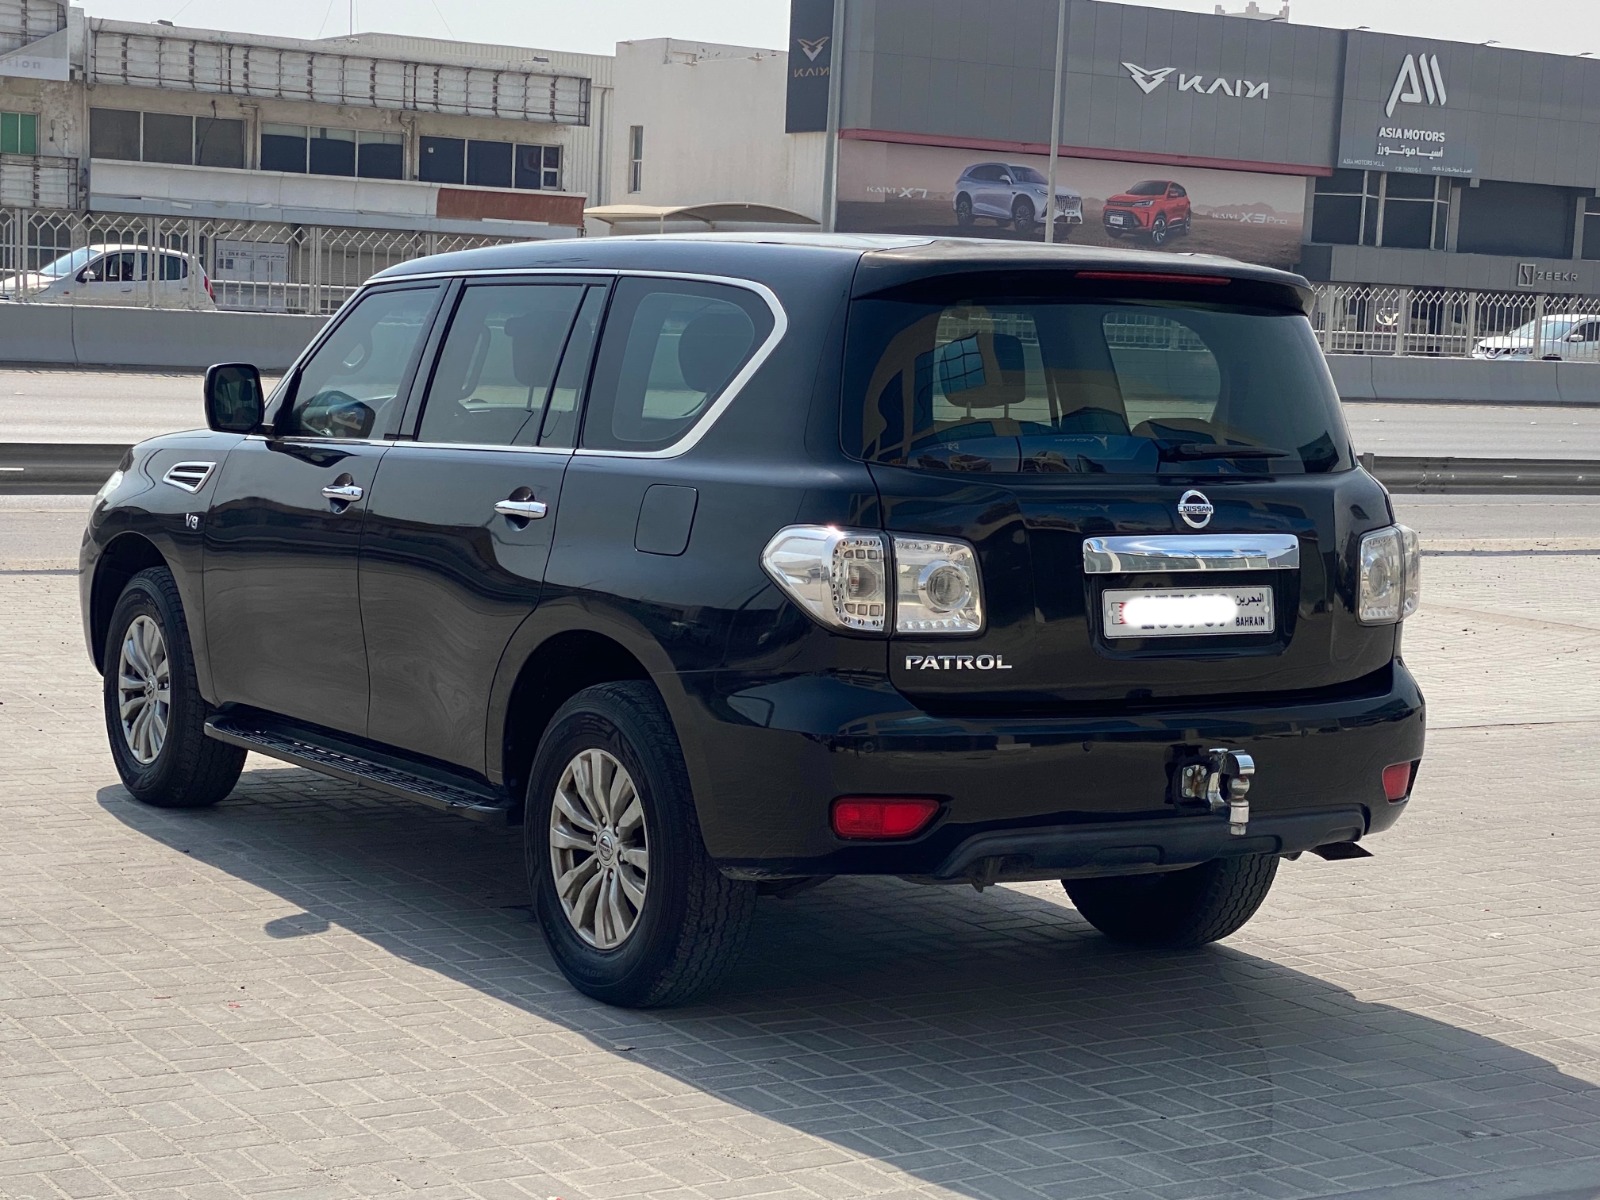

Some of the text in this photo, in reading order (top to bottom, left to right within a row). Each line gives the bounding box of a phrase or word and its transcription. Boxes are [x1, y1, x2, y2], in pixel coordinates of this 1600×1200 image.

[1379, 127, 1445, 142] ASIA MOTORS
[898, 187, 928, 199] X7
[1240, 212, 1267, 224] X3
[1537, 271, 1578, 281] ZEEKR
[185, 512, 199, 530] V8
[1235, 593, 1264, 606] البحرين
[1235, 616, 1265, 627] BAHRAIN
[905, 654, 1013, 670] PATROL
